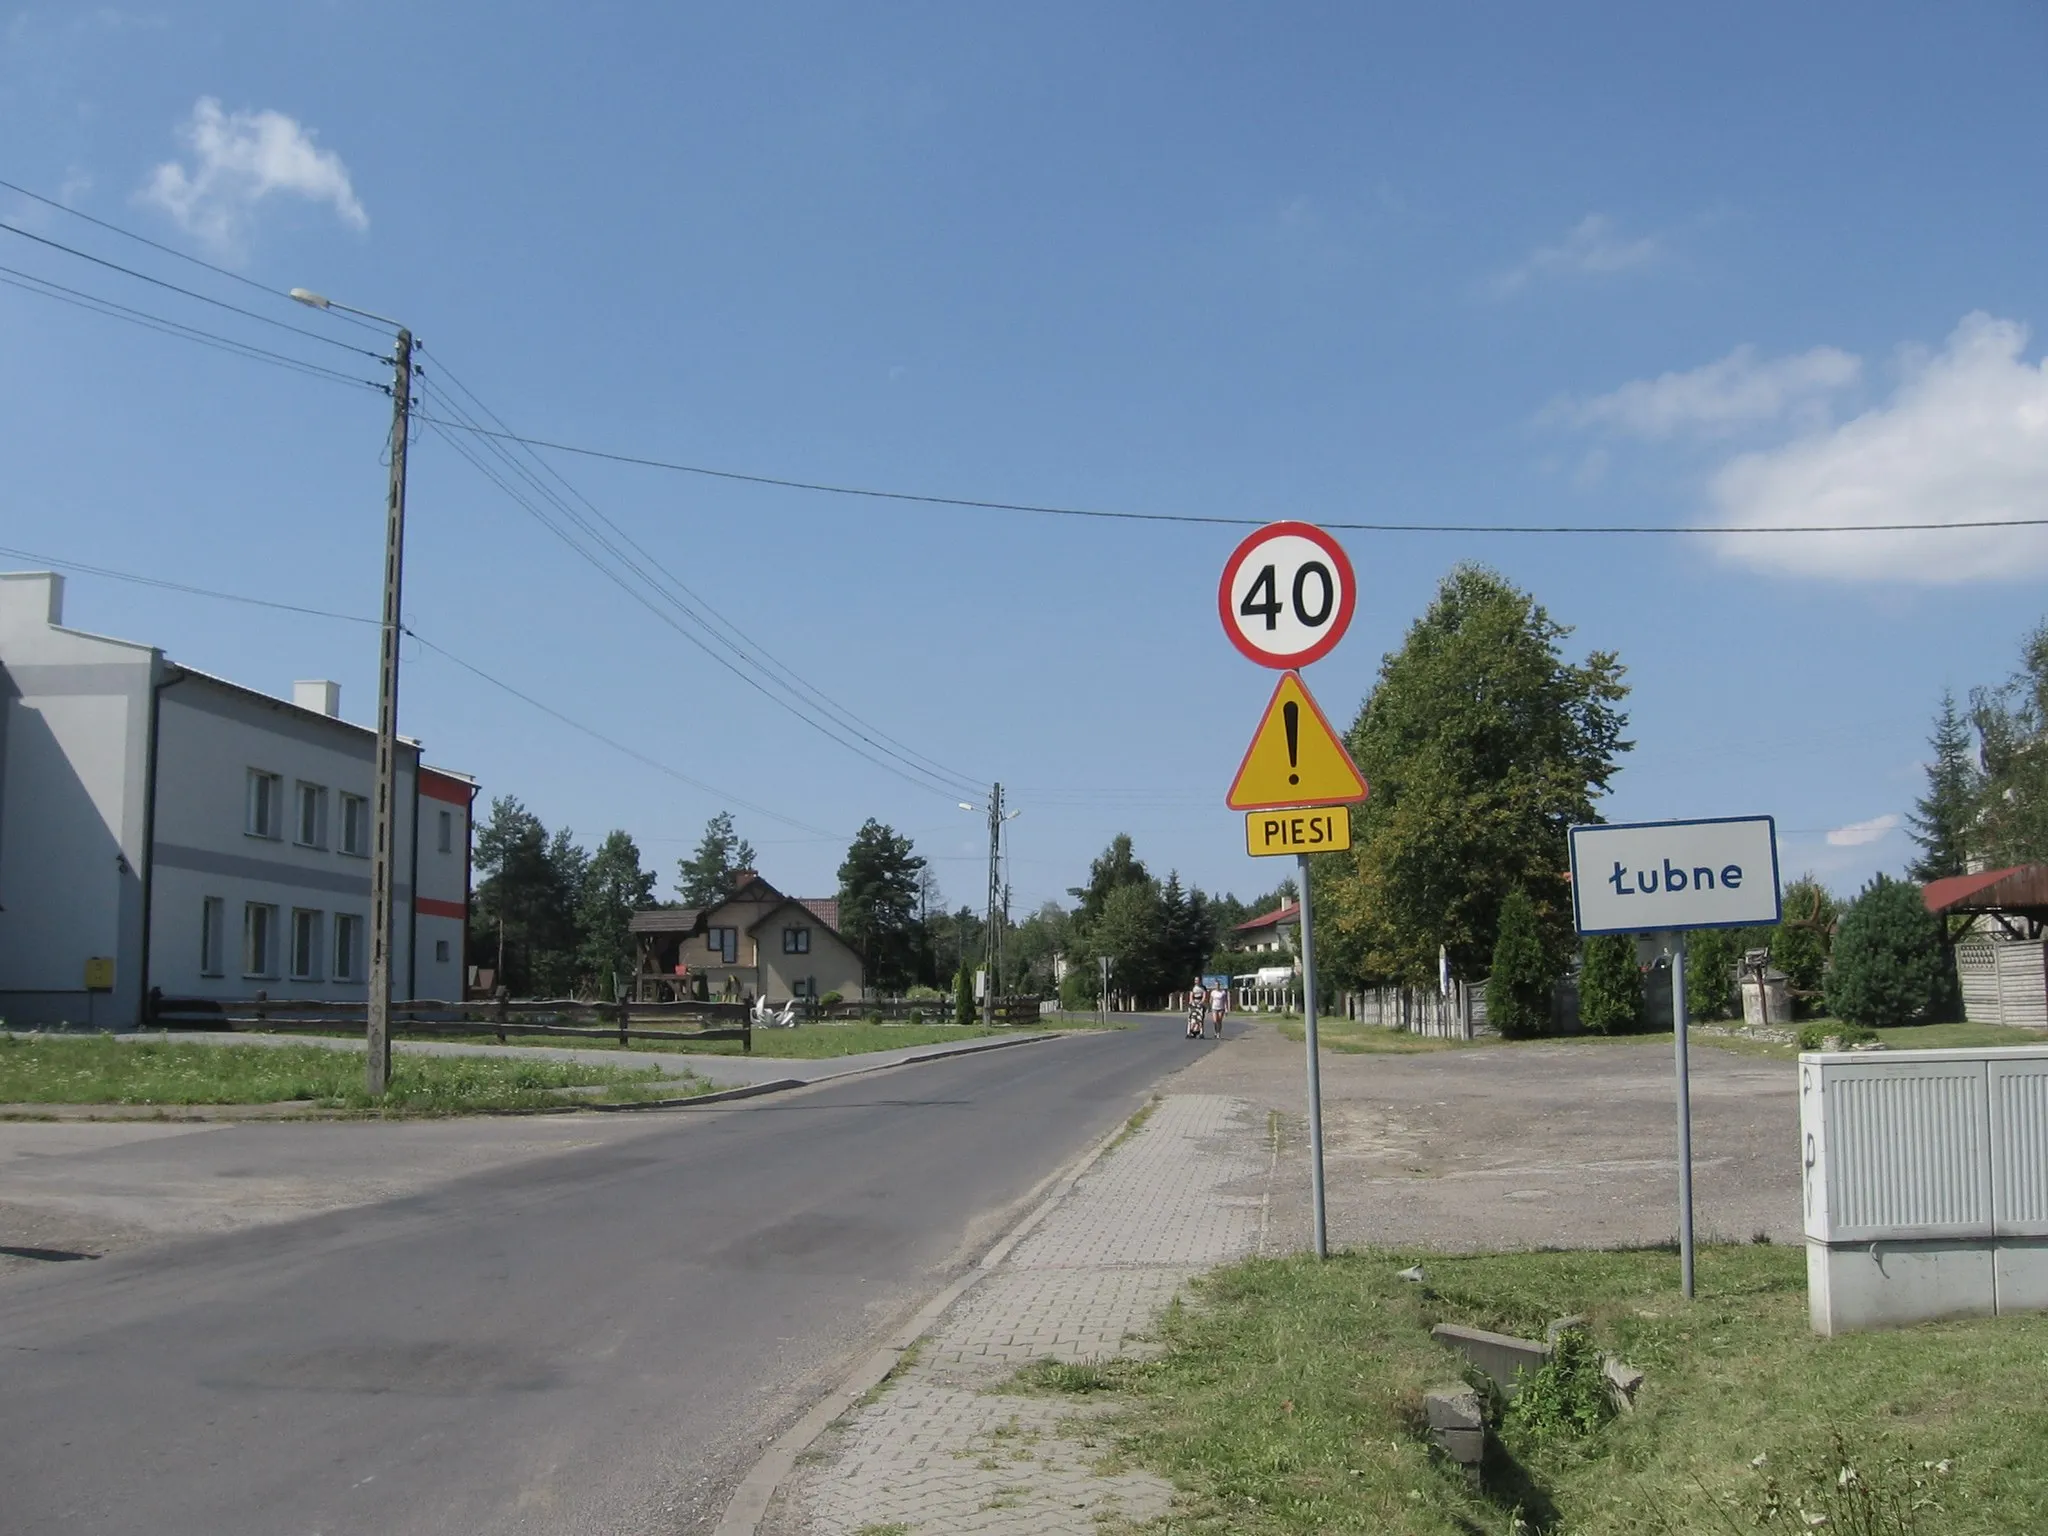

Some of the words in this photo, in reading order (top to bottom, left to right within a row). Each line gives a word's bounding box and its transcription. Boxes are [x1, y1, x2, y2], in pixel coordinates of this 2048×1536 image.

[1240, 561, 1334, 631] 40
[1264, 816, 1333, 846] PIESI
[1608, 858, 1743, 896] Łubne
